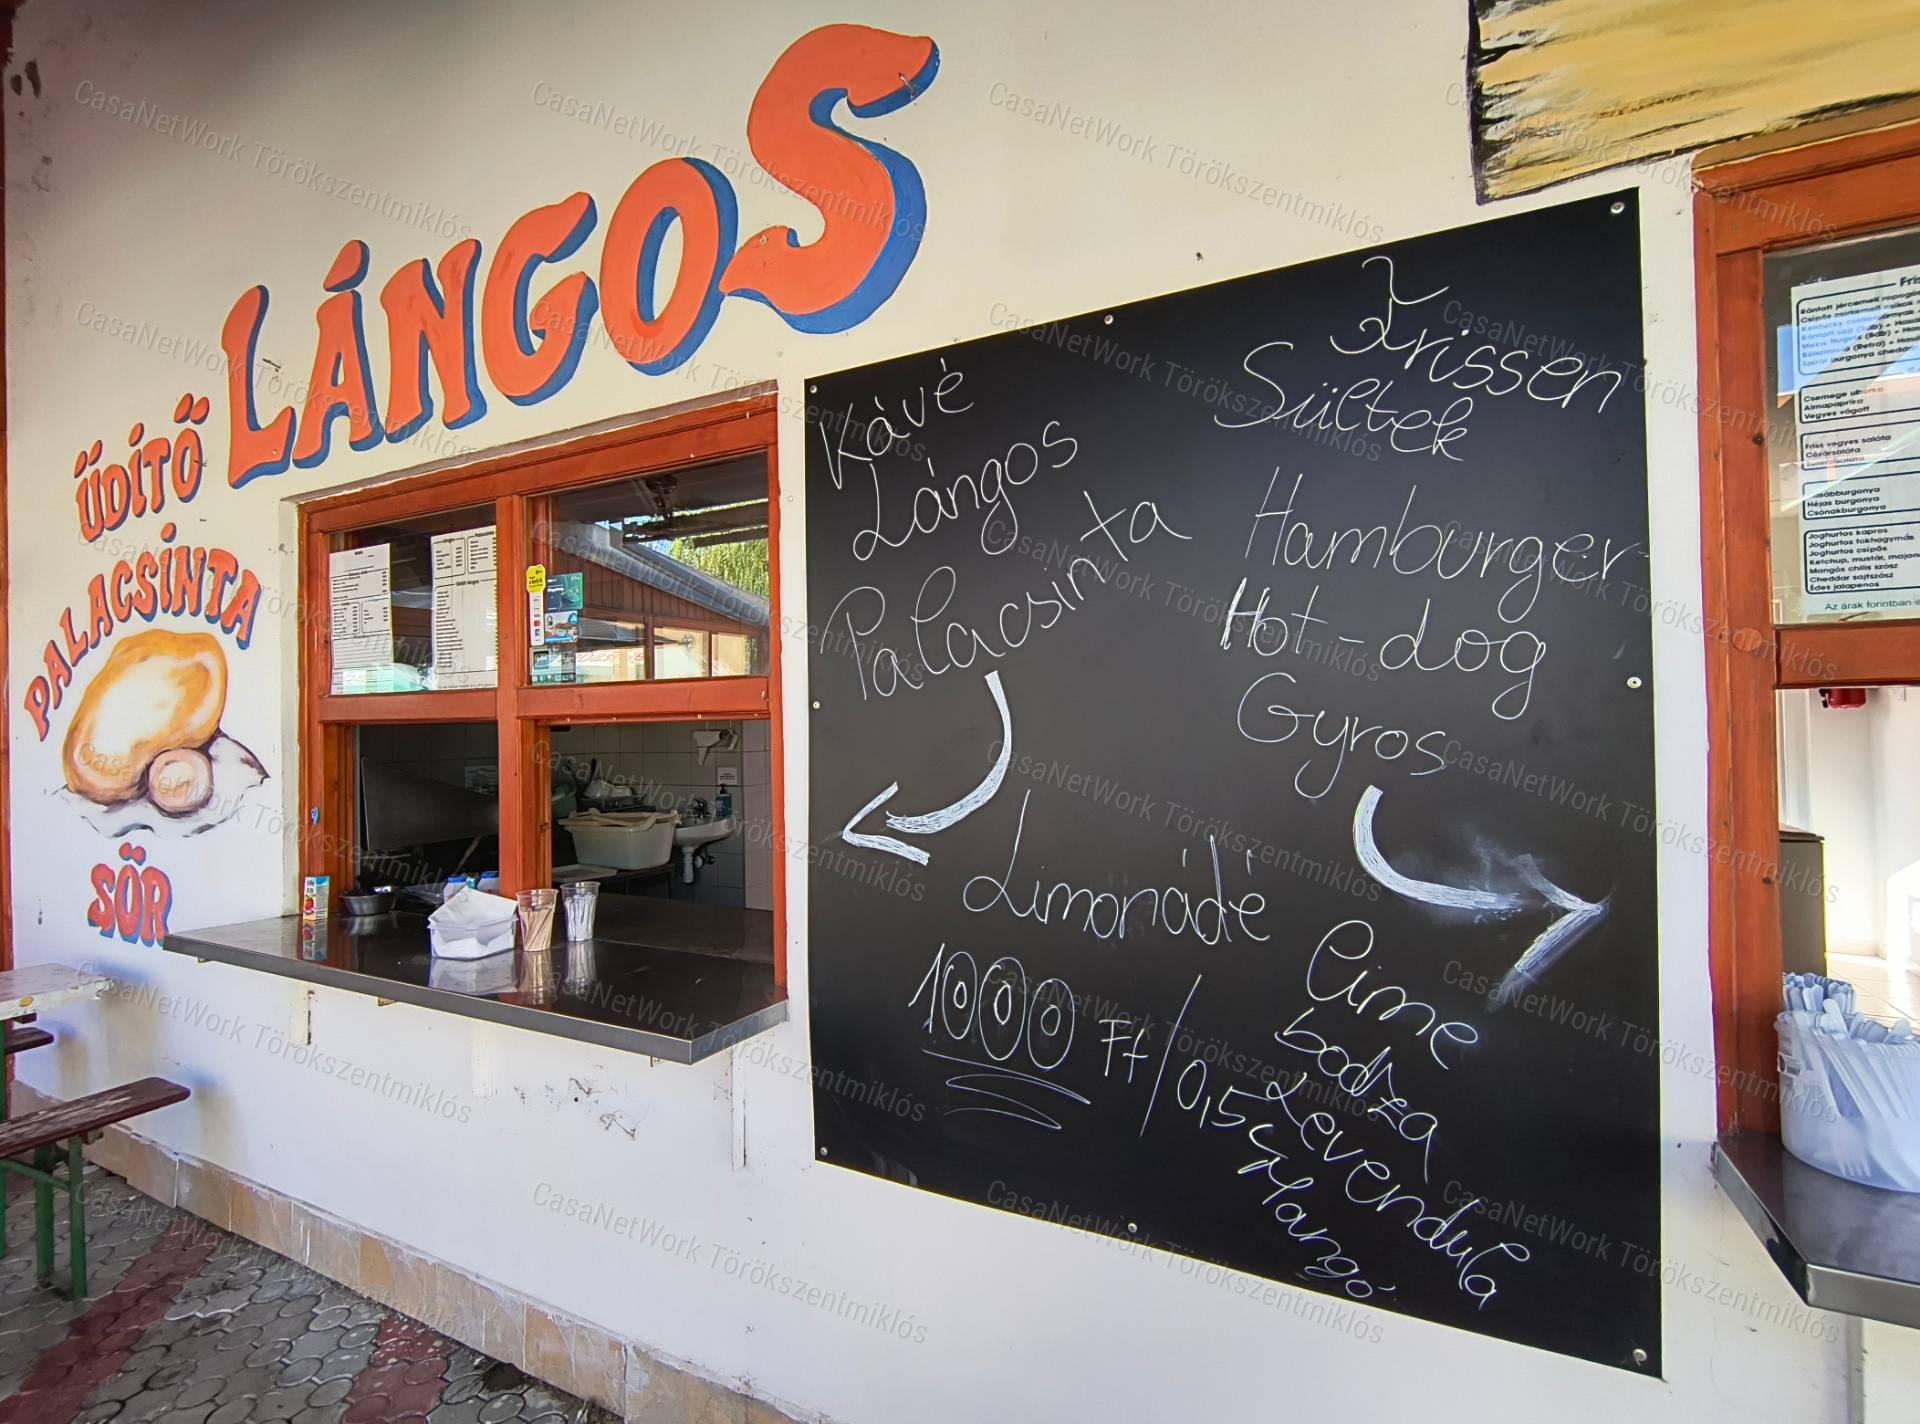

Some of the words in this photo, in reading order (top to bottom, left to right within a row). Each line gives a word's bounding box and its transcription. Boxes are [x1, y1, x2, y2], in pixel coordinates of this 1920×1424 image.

[221, 23, 940, 488] LÁNGOS
[820, 357, 974, 490] Kávé
[1213, 341, 1473, 461] Sültek
[852, 421, 1078, 561] Lángos
[1244, 466, 1640, 624] Hamburger
[1808, 530, 1853, 542] Joghurtos
[1855, 527, 1888, 538] kapros
[1808, 539, 1854, 550] Joghurtos
[1835, 495, 1880, 506] burgonya
[820, 490, 1193, 701] Palacsinta
[1809, 548, 1854, 559] Joghurtos
[1809, 574, 1850, 584] Cheddar
[1825, 602, 1839, 611] Az
[24, 522, 263, 741] PALACSINTA
[1237, 672, 1447, 799] Gyros
[87, 843, 172, 948] SÖR
[908, 942, 1076, 1070] 1000
